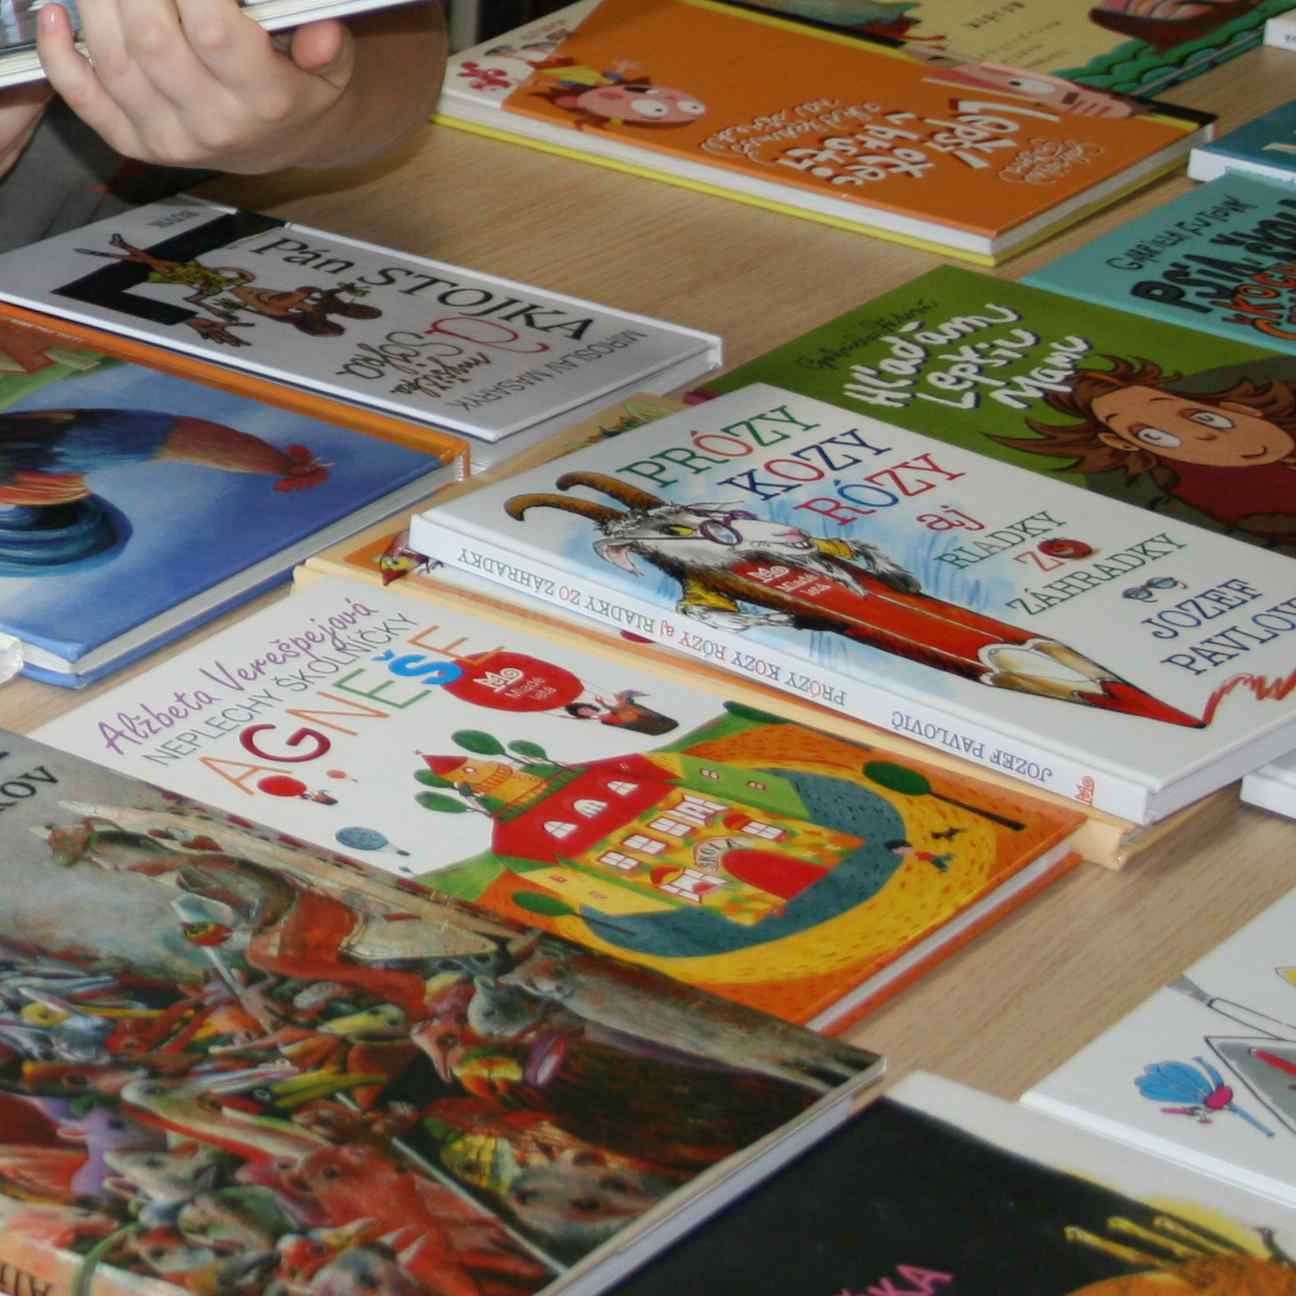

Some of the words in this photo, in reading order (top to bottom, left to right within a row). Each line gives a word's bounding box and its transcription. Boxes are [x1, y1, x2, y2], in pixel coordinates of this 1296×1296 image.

[247, 236, 357, 277] Pán
[357, 265, 600, 342] STOJKA
[616, 405, 821, 488] PRÓZY
[716, 428, 892, 502] KOZY
[794, 453, 966, 526] RÓZY
[916, 504, 985, 532] aj
[457, 546, 557, 598] ZÁHRADKY
[935, 510, 1068, 571] RIADKY
[1005, 533, 1187, 616] ZÁHRADKY
[582, 595, 656, 636] RIADKY
[1141, 578, 1264, 640] JOZEF
[97, 689, 223, 756] Alžbeta
[200, 597, 379, 693] Verešpejová
[142, 688, 286, 767] NEPLECHY
[274, 611, 420, 693] ŠKOLNÍČKY
[731, 651, 782, 682] KOZY
[199, 624, 506, 796] AGNEŠE
[891, 710, 987, 760] PAVLOVIČ
[990, 748, 1054, 783] JOZEF
